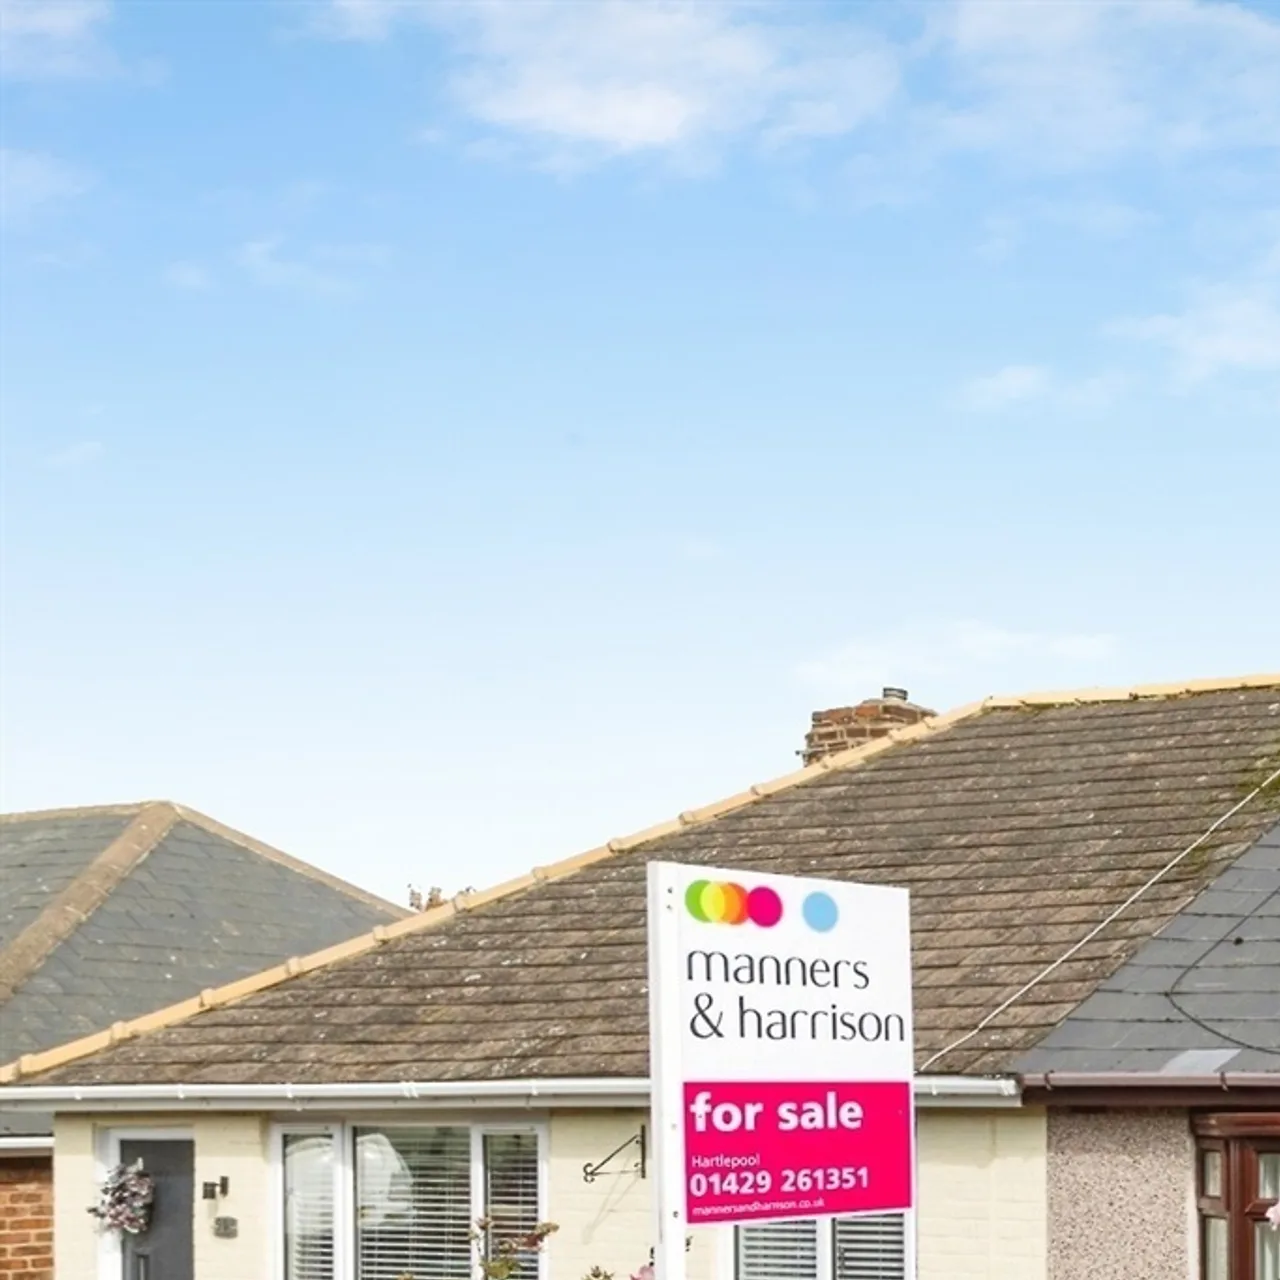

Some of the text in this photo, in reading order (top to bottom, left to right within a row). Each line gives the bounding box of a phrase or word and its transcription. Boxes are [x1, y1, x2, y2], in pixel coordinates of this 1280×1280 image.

[687, 950, 870, 989] manners
[689, 992, 905, 1041] & harrison
[689, 1091, 864, 1132] for sale
[692, 1153, 760, 1169] Hartlepool
[689, 1166, 869, 1197] 01429 261351
